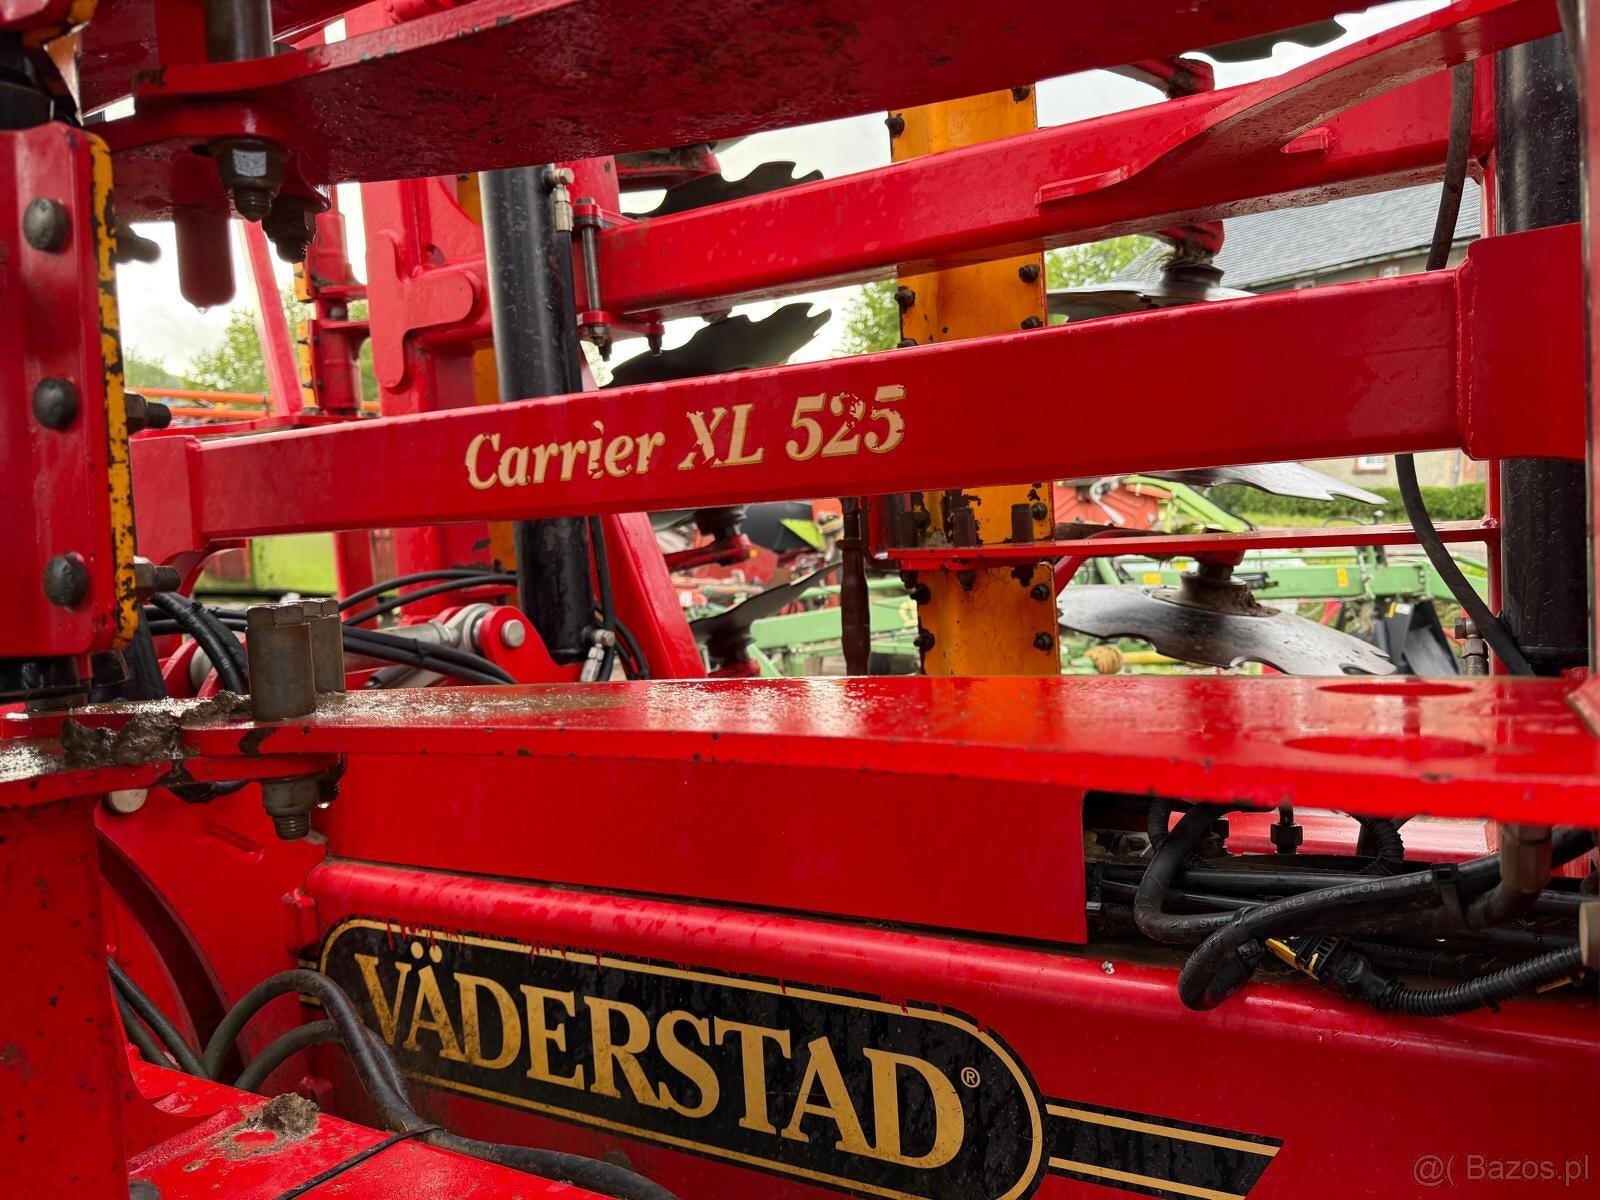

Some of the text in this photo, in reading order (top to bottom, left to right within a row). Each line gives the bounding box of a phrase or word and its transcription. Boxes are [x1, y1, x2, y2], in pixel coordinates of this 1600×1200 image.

[464, 385, 907, 490] Carrier XL 525
